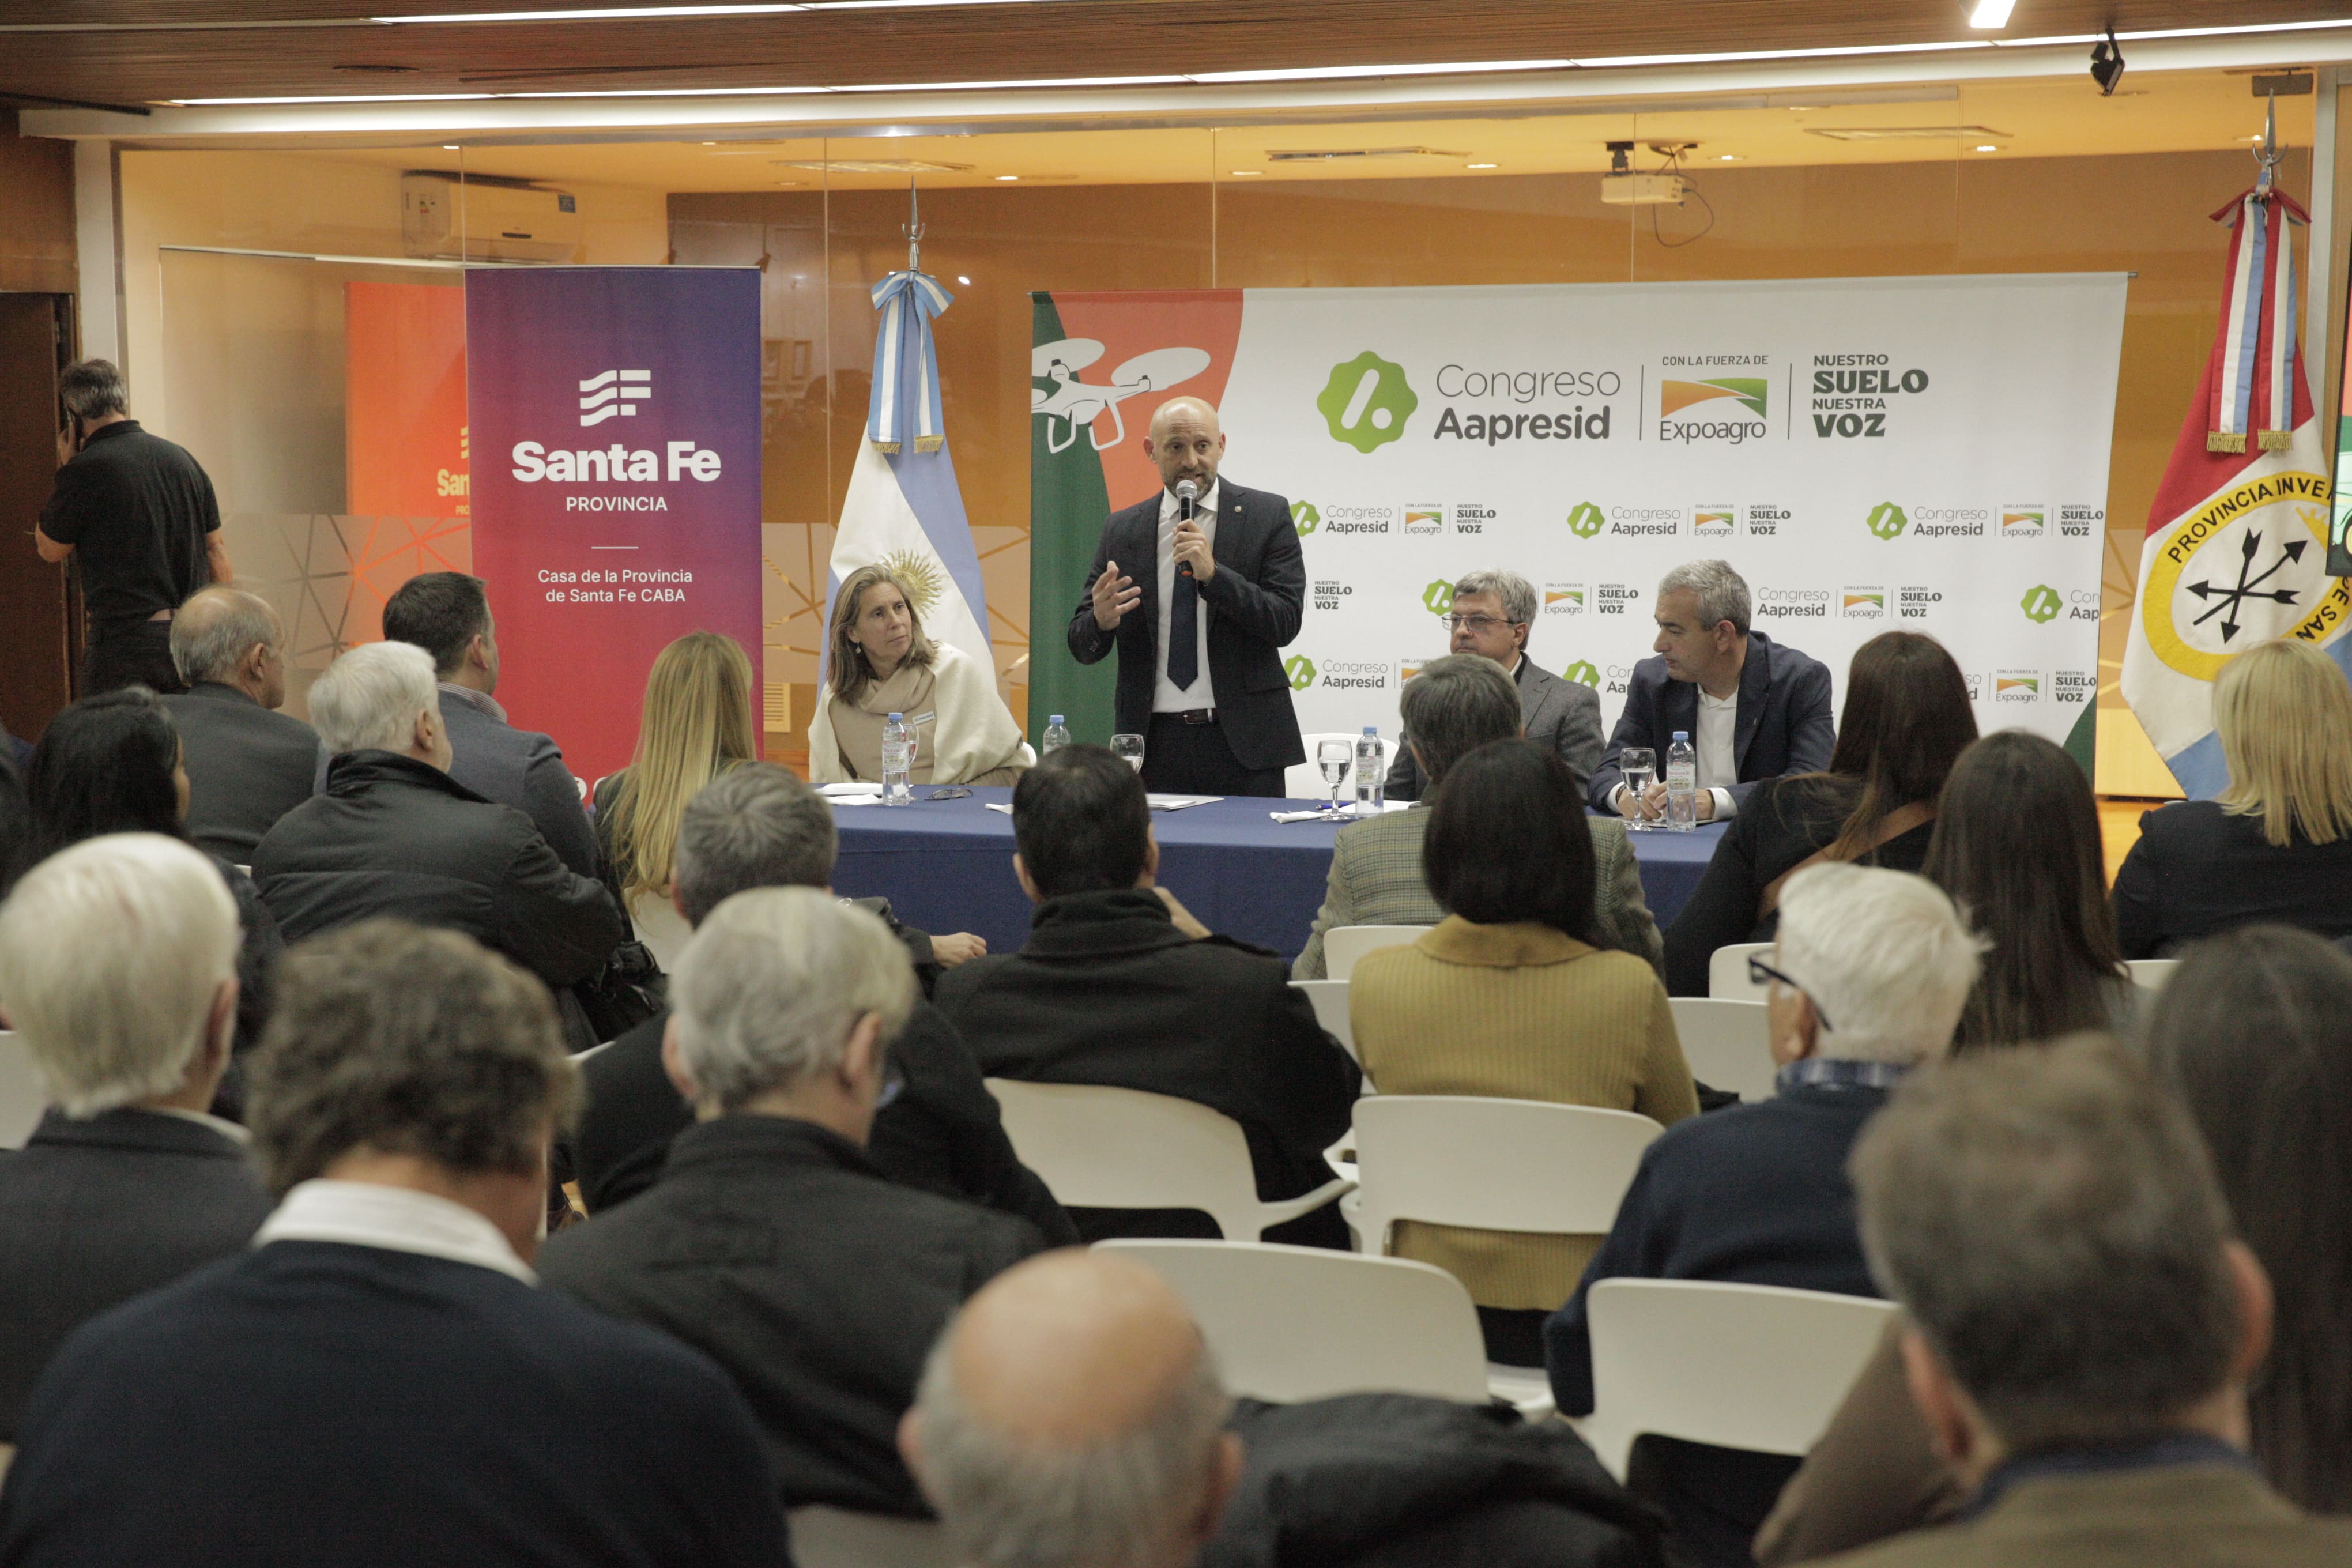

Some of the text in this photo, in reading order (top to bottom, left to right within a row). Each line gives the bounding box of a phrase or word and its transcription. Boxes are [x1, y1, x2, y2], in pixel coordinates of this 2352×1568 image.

[1662, 355, 1769, 366] CON LA FUERZA DE
[1814, 354, 1889, 366] NUESTRO
[1435, 364, 1620, 404] Congreso
[1813, 369, 1929, 394] SUELO
[1812, 398, 1887, 410] NUESTRA
[1434, 405, 1610, 447] Aapresid
[1812, 413, 1886, 438] VOZ
[1660, 420, 1766, 444] Expoagro
[512, 441, 722, 482] Santa Fe
[566, 496, 668, 511] PROVINCIA
[1326, 505, 1392, 520] Congreso
[1457, 510, 1497, 519] SUELO
[1612, 506, 1681, 522] Congreso
[1750, 510, 1791, 519] SUELO
[1914, 506, 1988, 522] Congreso
[2061, 510, 2104, 520] SUELO
[1325, 521, 1388, 535] Aapresid
[1457, 525, 1482, 534] VOZ
[1611, 522, 1677, 537] Aapresid
[2168, 483, 2274, 564] PROVINCIA
[1404, 526, 1442, 536] Expoagro
[1694, 527, 1733, 537] Expoagro
[1750, 526, 1776, 535] VOZ
[1913, 523, 1984, 538] Aapresid
[2002, 528, 2044, 538] Expoagro
[2061, 527, 2090, 536] VOZ
[538, 569, 693, 583] Casa de la Provincia
[546, 589, 686, 602] de Santa Fe CABA
[1314, 586, 1352, 595] SUELO
[1599, 590, 1639, 598] SUELO
[1758, 587, 1830, 603] Congreso
[1900, 592, 1942, 602] SUELO
[1314, 601, 1339, 609] VOZ
[1544, 606, 1583, 616] Expoagro
[1599, 605, 1624, 614] VOZ
[1758, 603, 1826, 618] Aapresid
[1843, 609, 1884, 619] Expoagro
[1901, 608, 1927, 617] VOZ
[1322, 659, 1388, 675] Congreso
[1322, 675, 1385, 690] Aapresid
[2055, 677, 2097, 686] SUELO
[1996, 693, 2038, 703] Expoagro
[2056, 693, 2084, 702] VOZ
